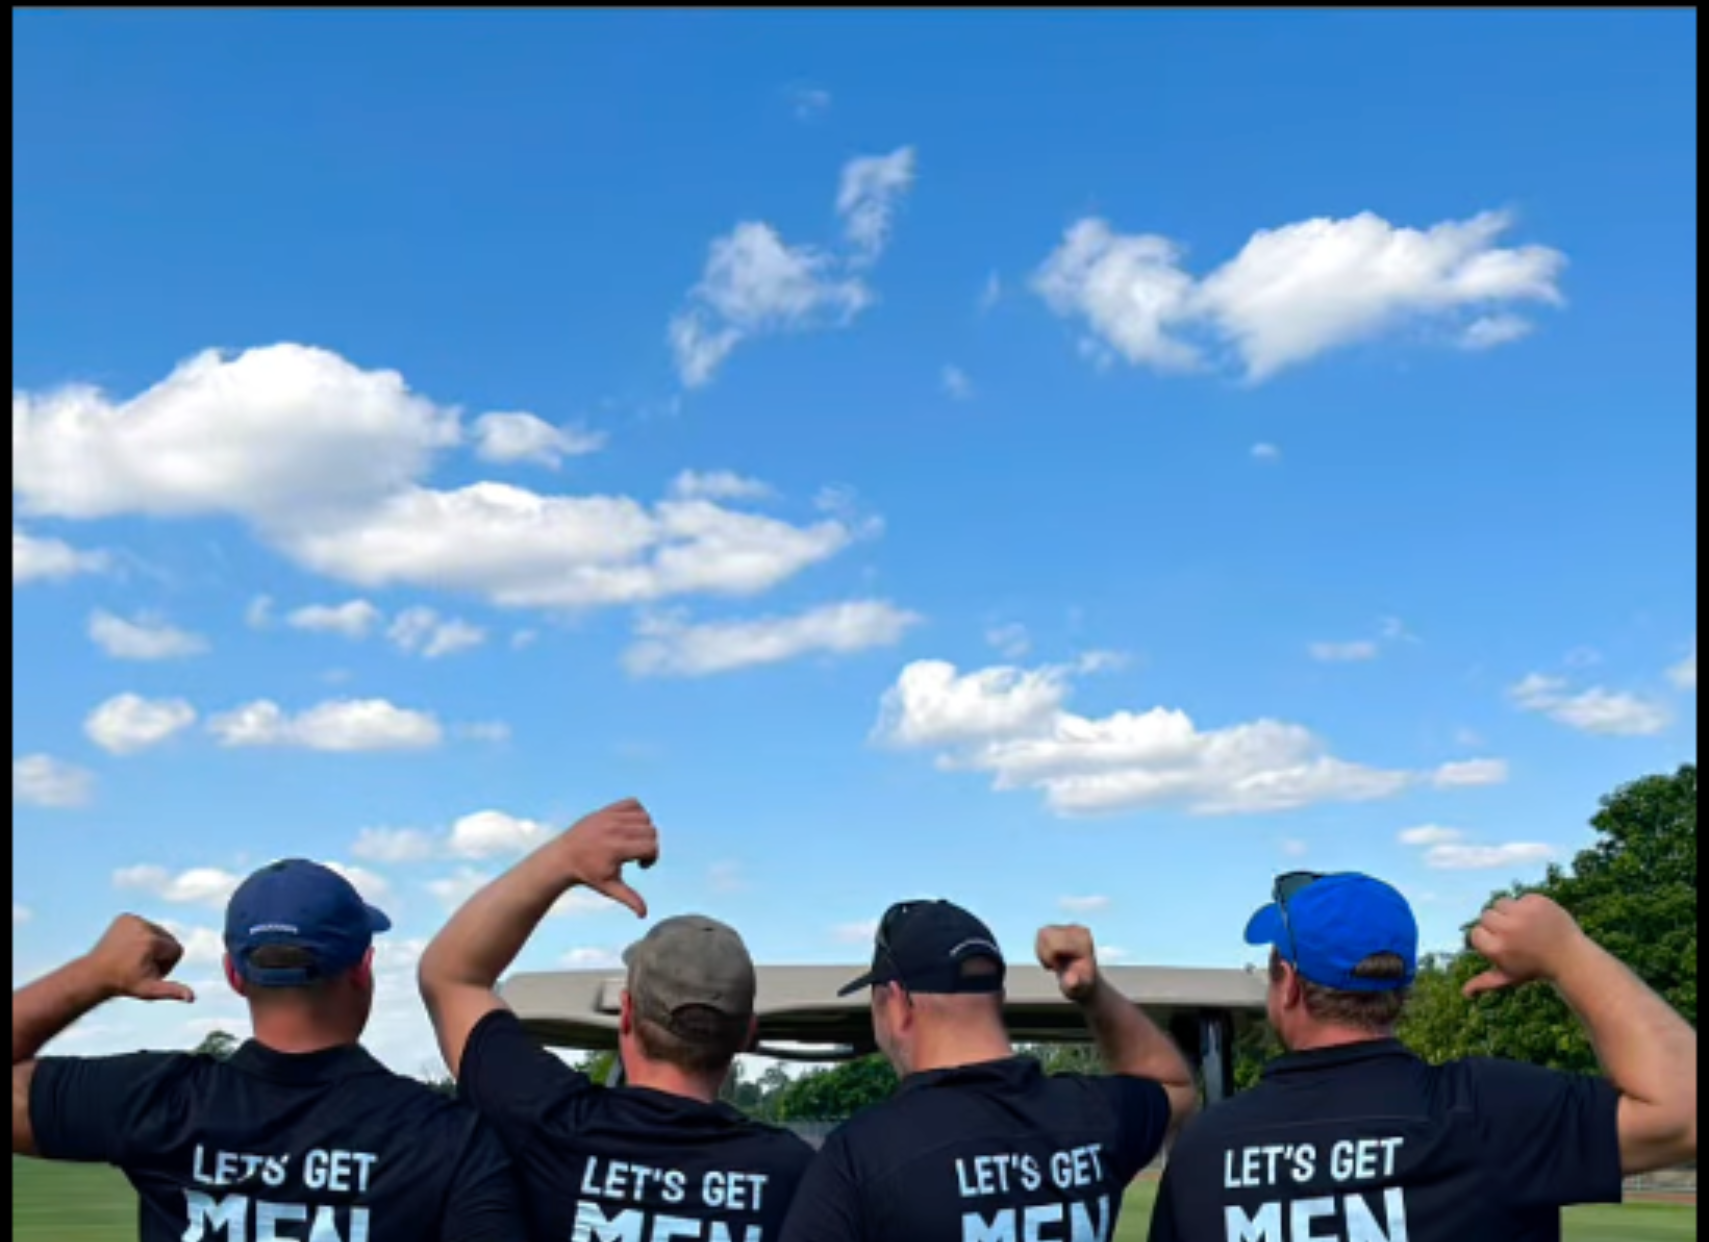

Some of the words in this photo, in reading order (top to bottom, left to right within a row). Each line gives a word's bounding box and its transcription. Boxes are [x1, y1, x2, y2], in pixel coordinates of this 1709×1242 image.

[304, 1149, 378, 1192] GET
[580, 1155, 687, 1203] LET'S
[702, 1170, 769, 1211] GET
[954, 1153, 1041, 1197] LET'S
[1051, 1143, 1102, 1188] GET
[1224, 1143, 1317, 1188] LET'S
[1330, 1136, 1404, 1181] GET
